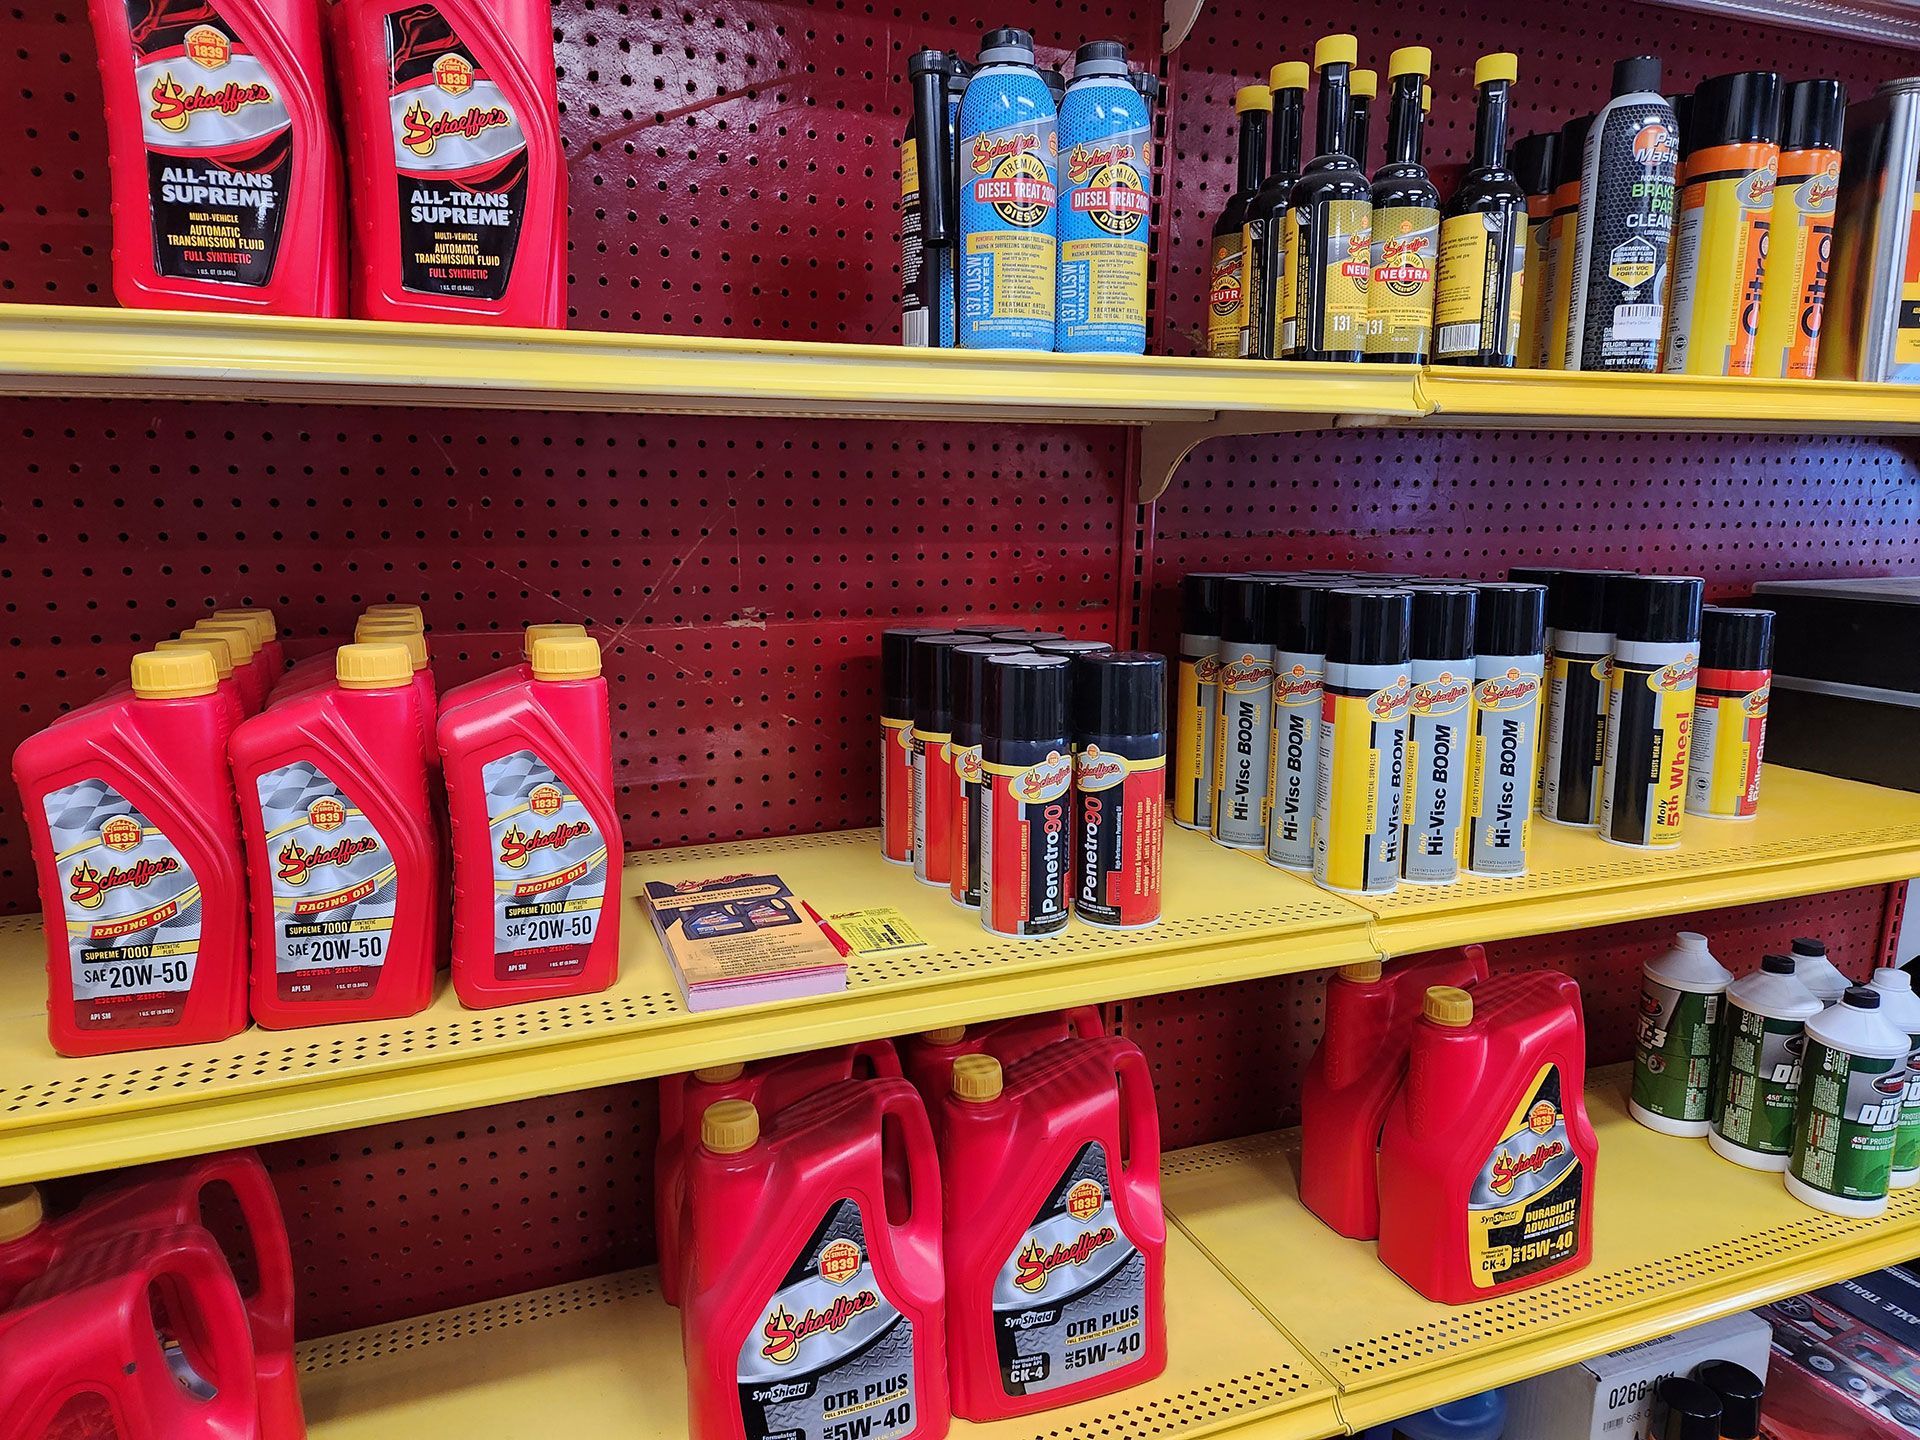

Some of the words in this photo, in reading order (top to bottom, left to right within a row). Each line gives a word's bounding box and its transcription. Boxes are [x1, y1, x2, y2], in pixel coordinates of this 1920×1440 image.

[194, 43, 224, 58] 1839
[440, 73, 467, 85] 1839
[151, 82, 269, 121] Schaeffer's
[402, 106, 507, 145] Schaeffer's
[161, 167, 273, 190] ALL-TRANS
[1002, 158, 1044, 180] PREMIUM
[1098, 168, 1138, 189] PREMIUM
[162, 184, 275, 209] SUPREME
[410, 190, 508, 208] ALL-TRANS
[978, 181, 1012, 199] DIESEL
[1012, 182, 1042, 198] TREAT
[1075, 191, 1109, 208] DIESEL
[1109, 191, 1137, 208] TREAT
[411, 206, 510, 227] SUPREME
[1004, 204, 1042, 222] DIESEL
[1099, 213, 1137, 231] DIESEL
[167, 235, 236, 250] TRANSMISSION
[239, 238, 265, 250] FLUID
[190, 225, 241, 238] AUTOMATIC
[184, 251, 206, 263] FULL
[207, 252, 252, 265] SYNTHETIC
[415, 253, 475, 266] TRANSMISSION
[477, 255, 500, 267] FLUID
[434, 243, 479, 255] AUTOMATIC
[429, 267, 447, 278] FULL
[448, 268, 488, 280] SYNTHETIC
[966, 257, 982, 292] ULSW
[1062, 264, 1078, 299] ULSW
[1380, 269, 1429, 281] NEUTRA
[1743, 221, 1771, 337] Citrol
[1801, 225, 1833, 339] Citrol
[1078, 263, 1086, 320] WINTER
[966, 295, 982, 316] 137
[1333, 315, 1350, 331] 131
[1366, 319, 1383, 335] 131
[1237, 701, 1254, 756] BOOM
[1287, 714, 1304, 773] BOOM
[1432, 724, 1451, 784] BOOM
[1474, 740, 1483, 765] SURFACES
[1499, 719, 1519, 778] BOOM
[1652, 734, 1661, 757] WEAR-OUT
[1670, 711, 1690, 790] Wheel
[1369, 752, 1377, 779] SURFACES
[1391, 729, 1405, 788] BOOM
[1407, 745, 1415, 770] SURFACES
[1651, 757, 1659, 779] RESISTS
[1406, 771, 1414, 794] VERTICAL
[1473, 765, 1481, 788] VERTICAL
[1233, 759, 1251, 821] Hi-Visc
[1367, 780, 1376, 804] VERTICAL
[535, 798, 558, 809] 1839
[1283, 775, 1301, 842] Hi-Visc
[1404, 802, 1412, 821] CLINGS
[1494, 782, 1514, 848] Hi-Visc
[1656, 799, 1669, 826] Moly
[1667, 795, 1680, 827] 5th
[314, 812, 340, 824] 1839
[1366, 812, 1374, 831] CLINGS
[1386, 795, 1401, 863] Hi-Visc
[1428, 789, 1447, 856] Hi-Visc
[108, 832, 136, 843] 1839
[500, 821, 591, 863] Schaeffer's
[1418, 832, 1428, 855] Moly
[1485, 825, 1494, 847] Moly
[278, 837, 377, 879] Schaeffer's
[1042, 804, 1062, 914] Penetro90
[1083, 796, 1102, 903] Penetro90
[71, 857, 178, 900] Schaeffer's
[517, 878, 564, 895] RACING
[567, 867, 587, 882] OIL
[1134, 866, 1142, 895] Penetrates
[297, 896, 348, 913] RACING
[352, 884, 374, 899] OIL
[508, 906, 539, 916] SUPREME
[539, 903, 562, 915] 7000
[1020, 898, 1028, 917] TRIPLES
[93, 919, 149, 938] RACING
[152, 907, 175, 923] OIL
[289, 925, 322, 935] SUPREME
[322, 922, 348, 934] 7000
[507, 924, 527, 937] SAE
[528, 916, 592, 942] 20W-50
[84, 950, 120, 961] SUPREME
[120, 947, 149, 960] 7000
[288, 943, 309, 957] SAE
[311, 936, 382, 962] 20W-50
[84, 971, 108, 983] SAE
[110, 960, 188, 989] 20W-50
[1826, 1048, 1834, 1062] TCC
[1533, 1115, 1552, 1127] 1839
[1857, 1103, 1901, 1125] DOT
[1491, 1142, 1563, 1189] Schaeffer's
[1072, 1197, 1099, 1212] 1839
[1525, 1198, 1576, 1223] DURABILITY
[1480, 1210, 1518, 1225] SynShield
[1524, 1210, 1575, 1235] ADVANTAGE
[1015, 1227, 1115, 1285] Schaeffer's
[1512, 1247, 1521, 1264] SAE
[1520, 1231, 1574, 1262] 15W-40
[825, 1256, 855, 1273] 1839
[1482, 1258, 1506, 1271] CK-4
[763, 1291, 875, 1356] Schaeffer's
[1004, 1310, 1053, 1328] SynShield
[1066, 1316, 1098, 1338] OTR
[1102, 1304, 1140, 1326] PLUS
[1881, 1302, 1920, 1325] AXLE
[1078, 1331, 1102, 1343] SYNTHETIC
[1065, 1351, 1075, 1371] SAE
[1074, 1332, 1141, 1369] 5W-40
[1010, 1367, 1044, 1384] CK-4
[752, 1384, 808, 1402] SynShield
[823, 1389, 860, 1412] OTR
[864, 1373, 908, 1397] PLUS
[1608, 1370, 1676, 1410] 0266-0
[837, 1404, 864, 1416] SYNTHETIC
[864, 1398, 882, 1409] DIESEL
[881, 1393, 900, 1405] ENGINE
[833, 1402, 911, 1440] 5W-40
